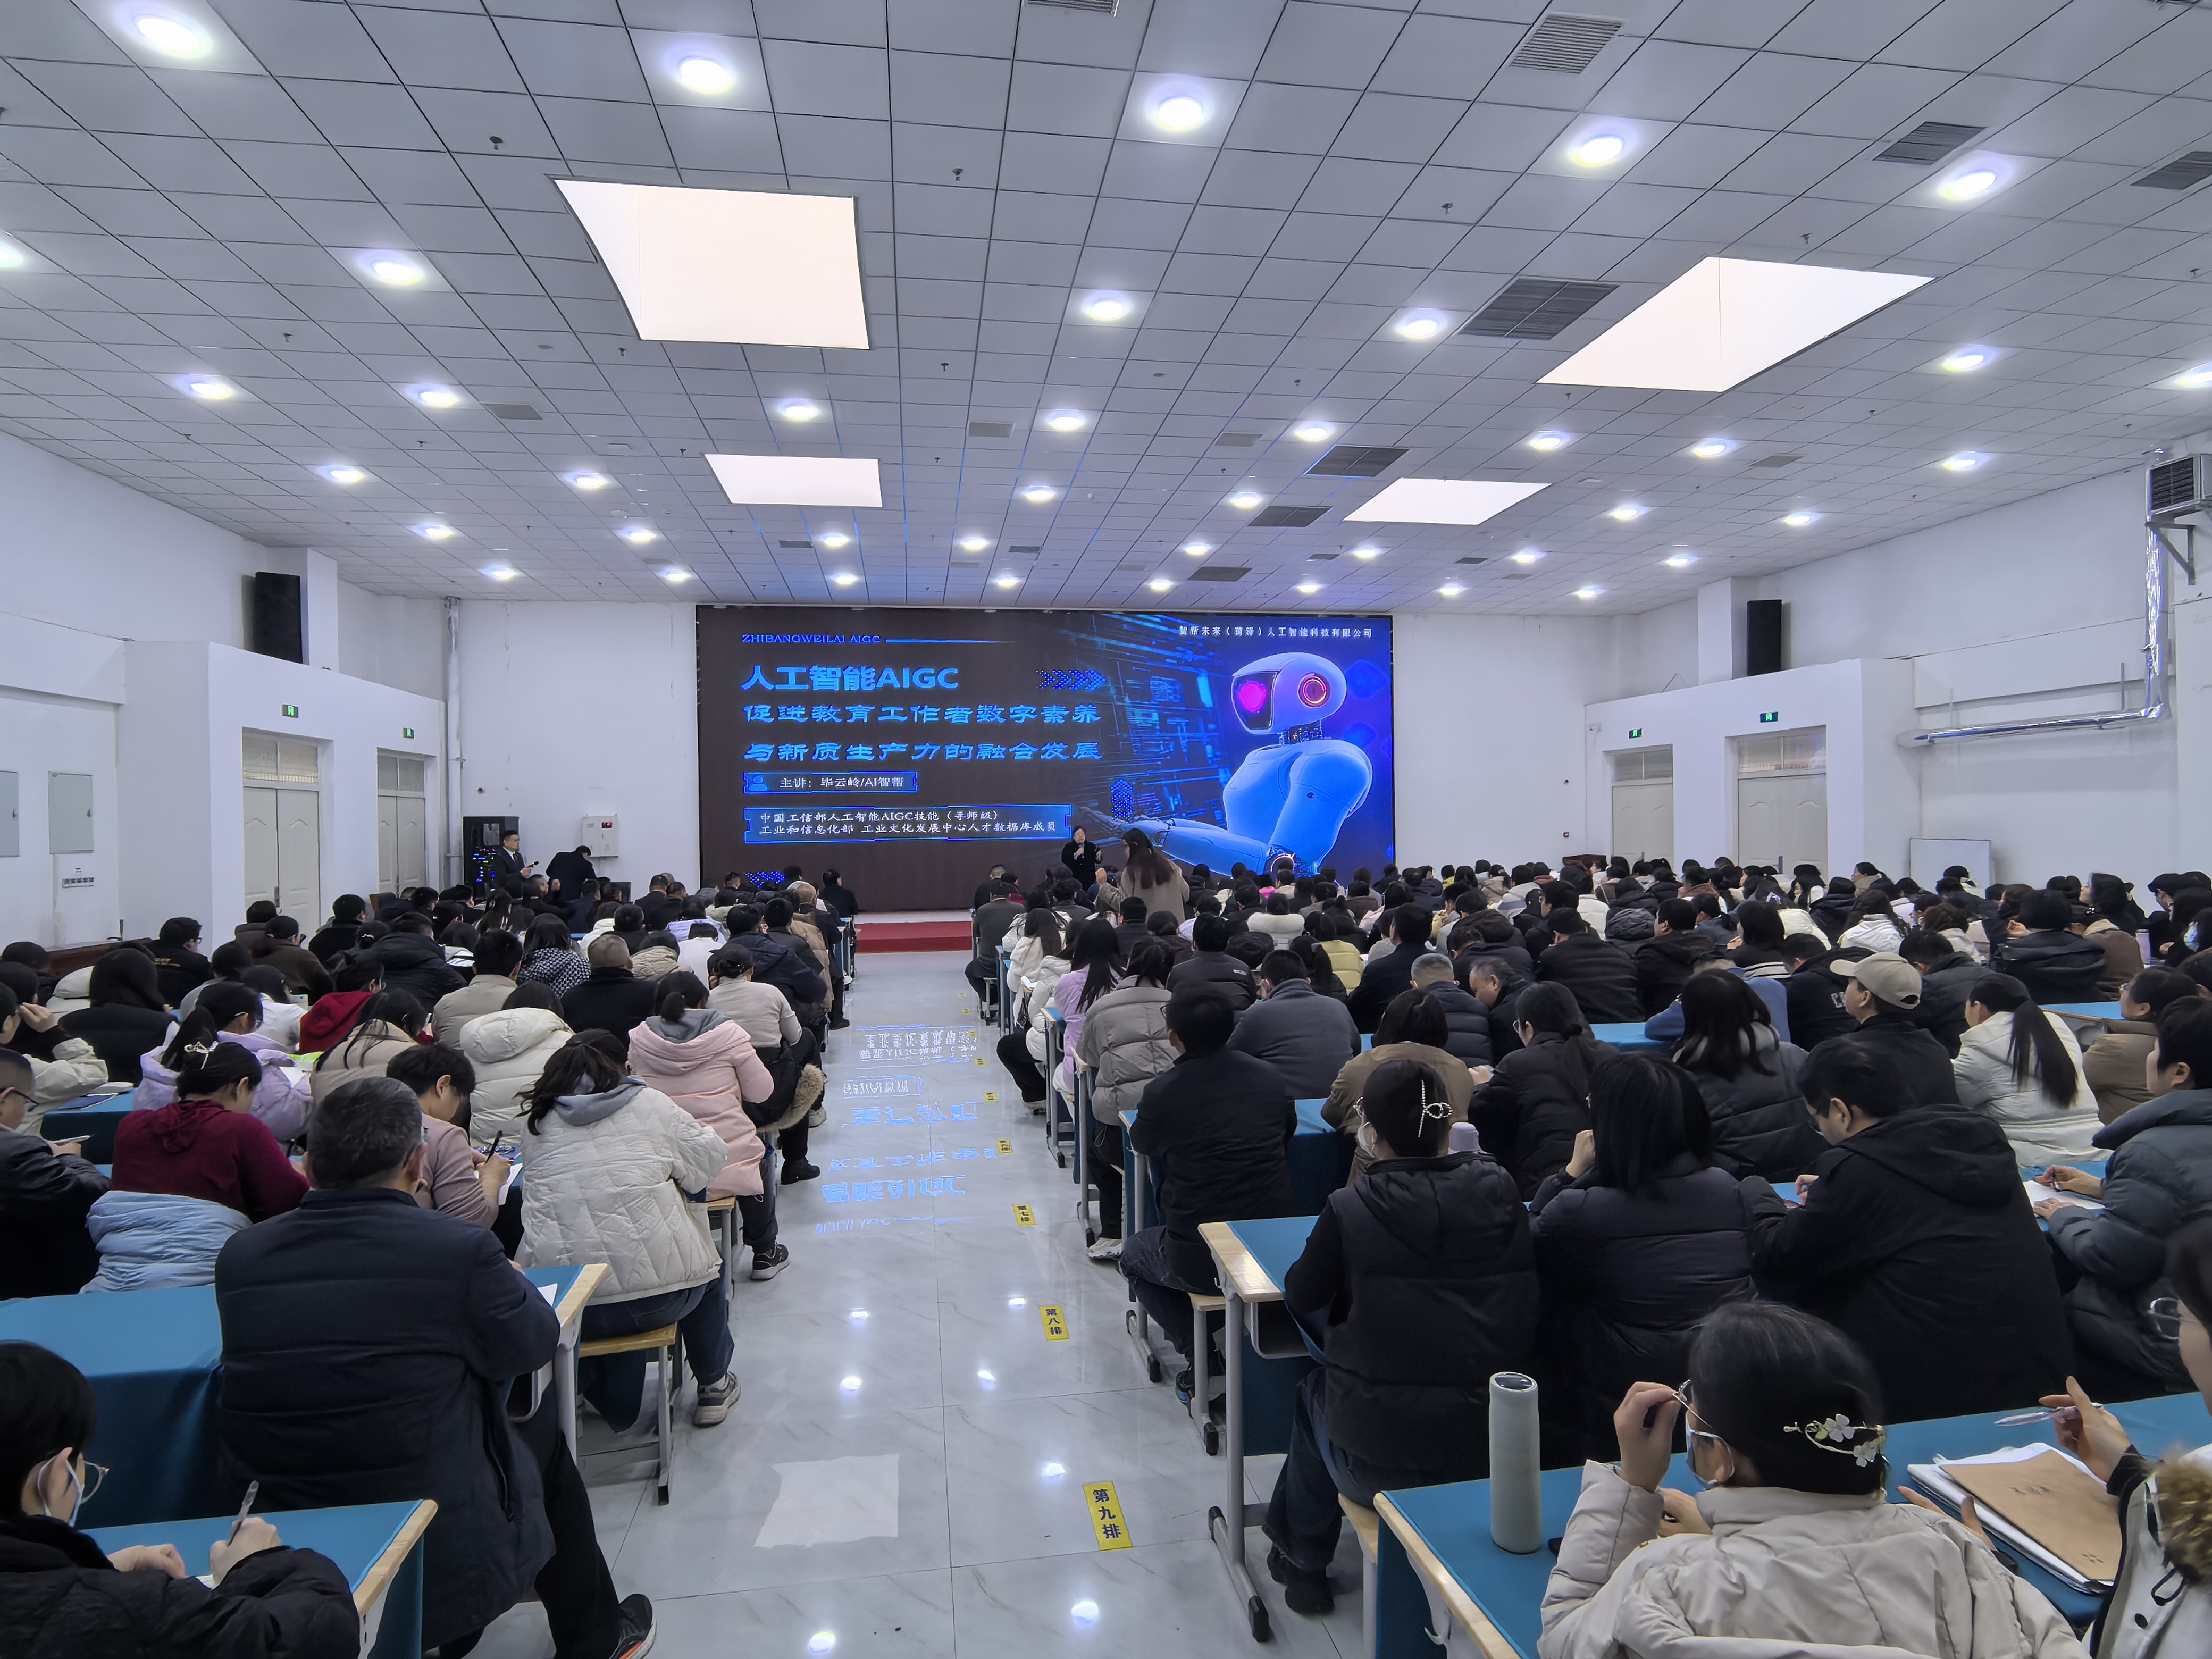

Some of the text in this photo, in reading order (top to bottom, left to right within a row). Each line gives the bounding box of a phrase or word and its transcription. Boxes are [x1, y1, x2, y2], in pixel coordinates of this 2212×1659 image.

[742, 634, 881, 644] ZHIBANGWEILAI AIGC
[741, 665, 959, 690] 人工智能AIGC
[743, 705, 1101, 724] 促进教育工作者数字素养
[743, 743, 1102, 761] 与新质生产力的融合发展
[759, 823, 853, 835] 工业和信息化部
[1045, 1308, 1062, 1336] 第八排
[1092, 1488, 1121, 1538] 第九排
